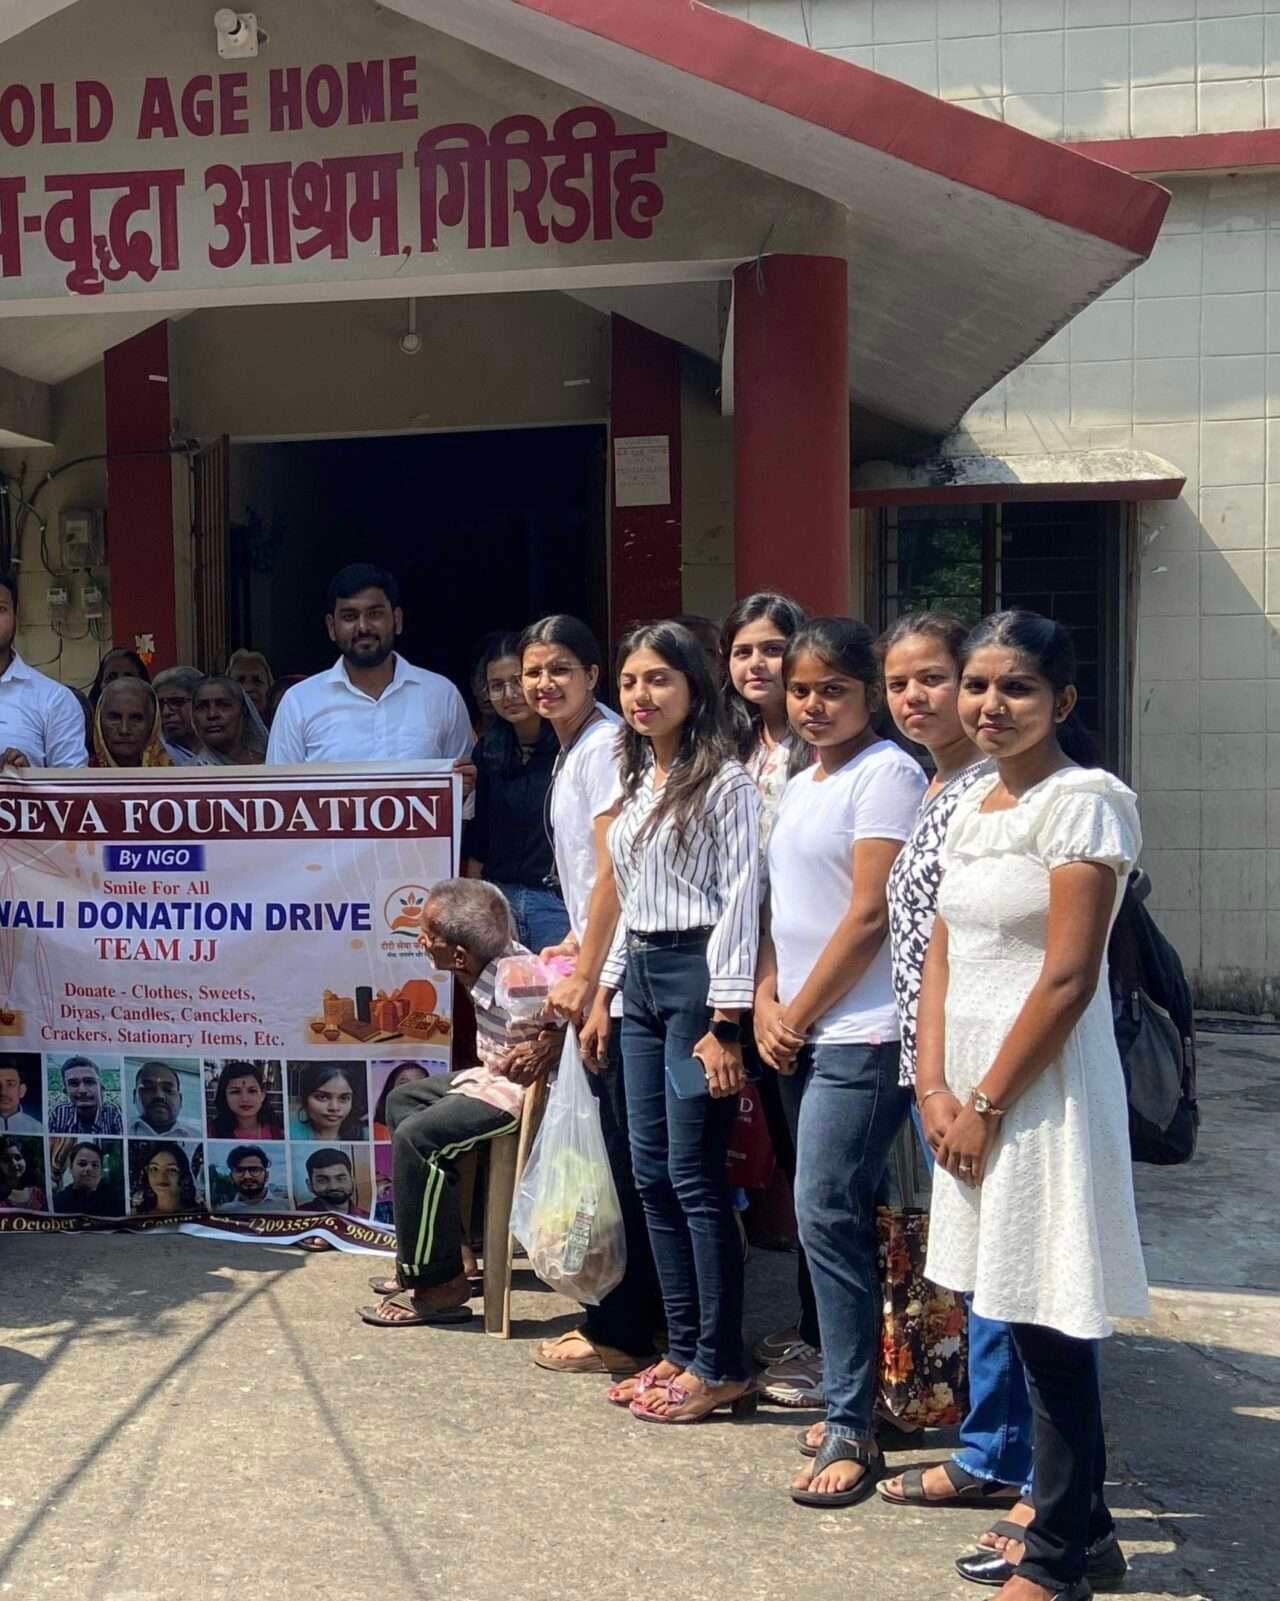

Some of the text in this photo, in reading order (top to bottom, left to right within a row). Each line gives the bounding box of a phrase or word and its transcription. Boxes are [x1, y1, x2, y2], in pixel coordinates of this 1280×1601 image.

[137, 72, 249, 139] AGE
[268, 56, 419, 132] HOME
[120, 795, 441, 834] FOUNDATION
[119, 849, 190, 869] By NGO
[103, 880, 210, 895] Smile For All
[78, 901, 253, 931] DONATION
[266, 902, 372, 931] DRIVE
[94, 938, 218, 962] TEAM JJ
[64, 982, 116, 998] Donate
[131, 984, 193, 1001] Clothes,
[199, 984, 256, 1002] Sweets,
[60, 1004, 105, 1022] Diyas,
[111, 1006, 175, 1023] Candles,
[41, 1025, 285, 1048] Crackers, Stationary Items, Etc.
[12, 1217, 76, 1231] October
